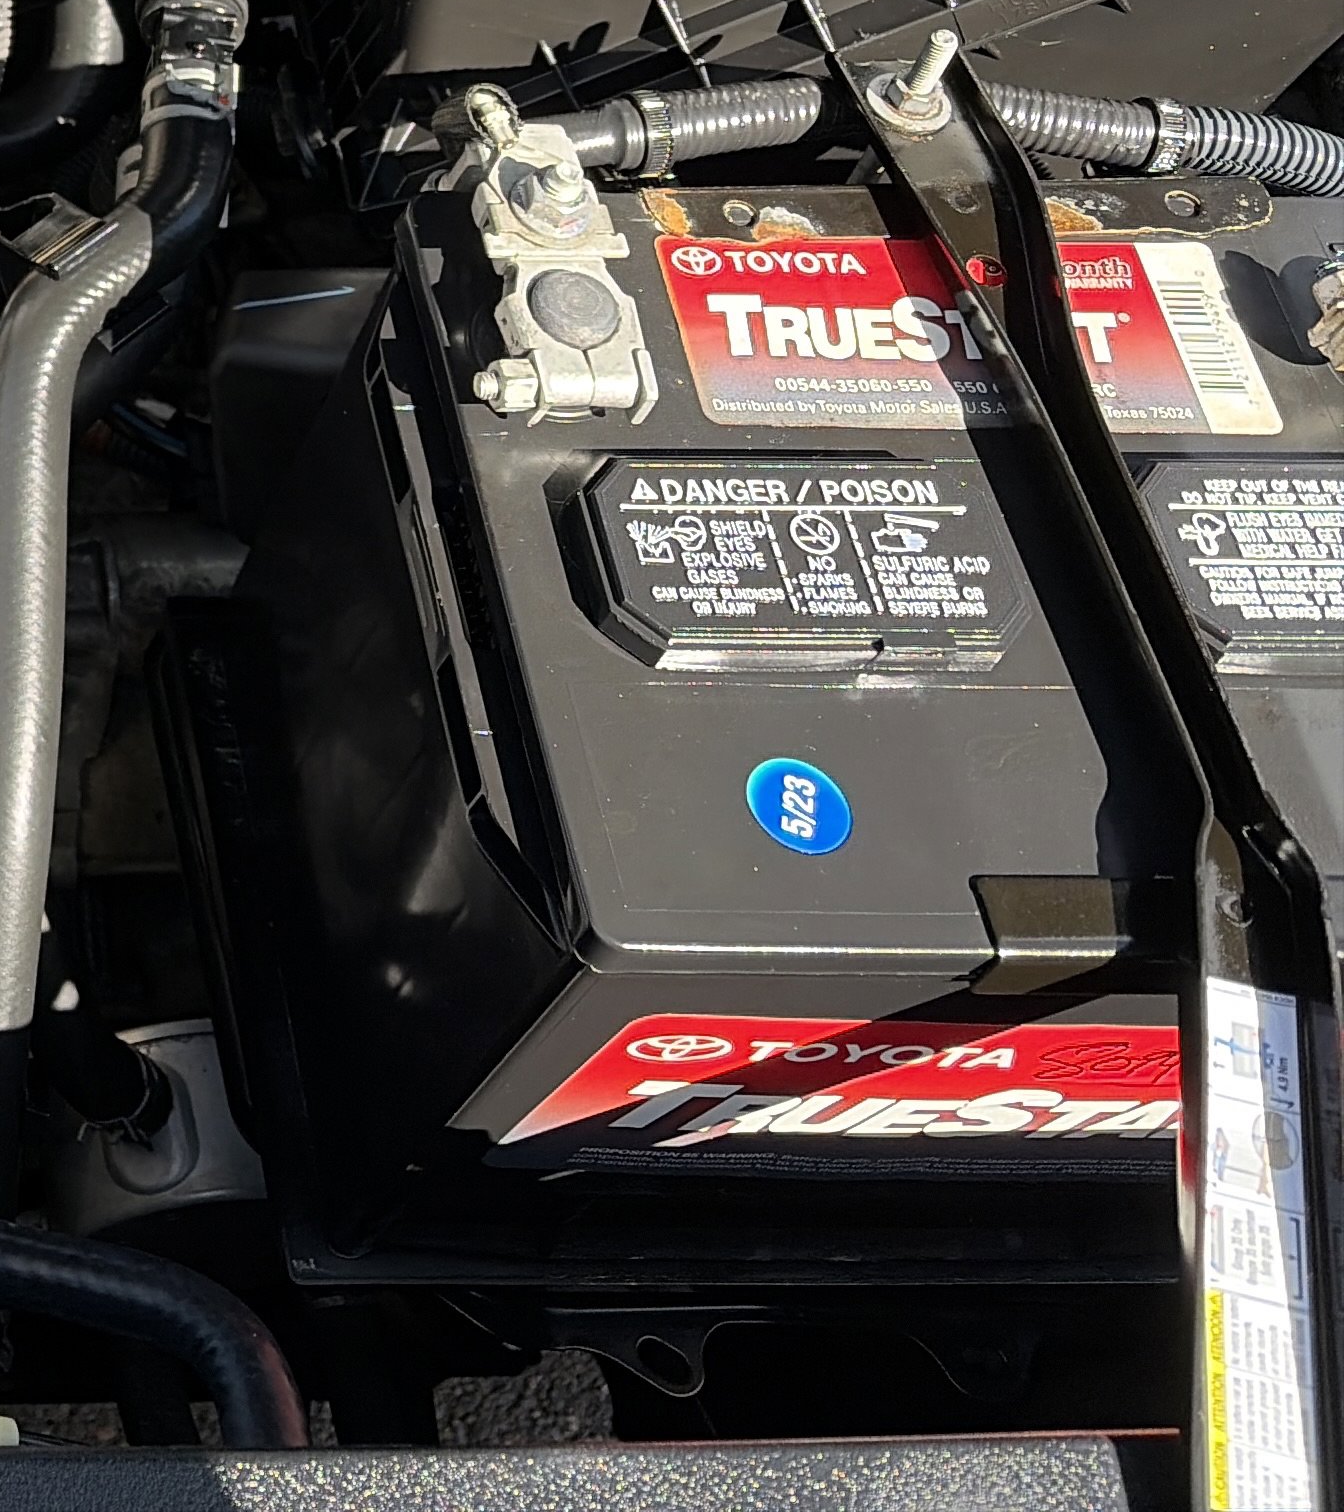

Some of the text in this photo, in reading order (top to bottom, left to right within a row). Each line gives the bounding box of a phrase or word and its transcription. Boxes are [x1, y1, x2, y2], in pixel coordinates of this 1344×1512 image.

[725, 250, 867, 276] TOYOTA
[774, 376, 933, 394] 00544-35060-550
[954, 380, 989, 395] 550
[712, 397, 795, 414] Distributed
[798, 399, 815, 417] by
[815, 399, 868, 418] Toyota
[870, 400, 918, 416] Motor
[919, 399, 962, 416] Sales
[1104, 405, 1149, 420] Texas
[1150, 406, 1195, 421] 75024
[659, 478, 790, 503] DANGER
[818, 479, 939, 504] POISON
[1181, 491, 1203, 505] DO
[709, 520, 767, 537] SHIELD
[714, 537, 757, 552] EYES
[681, 552, 767, 569] EXPLOSIVE
[806, 555, 837, 572] NO
[871, 555, 991, 574] SULFURIC ACID
[687, 569, 739, 585] GASES
[798, 573, 855, 586] SPARKS
[877, 572, 957, 586] CAN CAUSE
[651, 586, 786, 601] CAN CAUSE BLINDNESS
[803, 587, 858, 600] FLAMES
[882, 586, 985, 601] BLINDNESS OR
[692, 601, 757, 616] OR INJURY
[808, 601, 872, 615] SMOKING
[888, 601, 989, 617] SEVERE BURNS
[780, 774, 817, 839] 5/23
[748, 1040, 1016, 1069] TOYOTA
